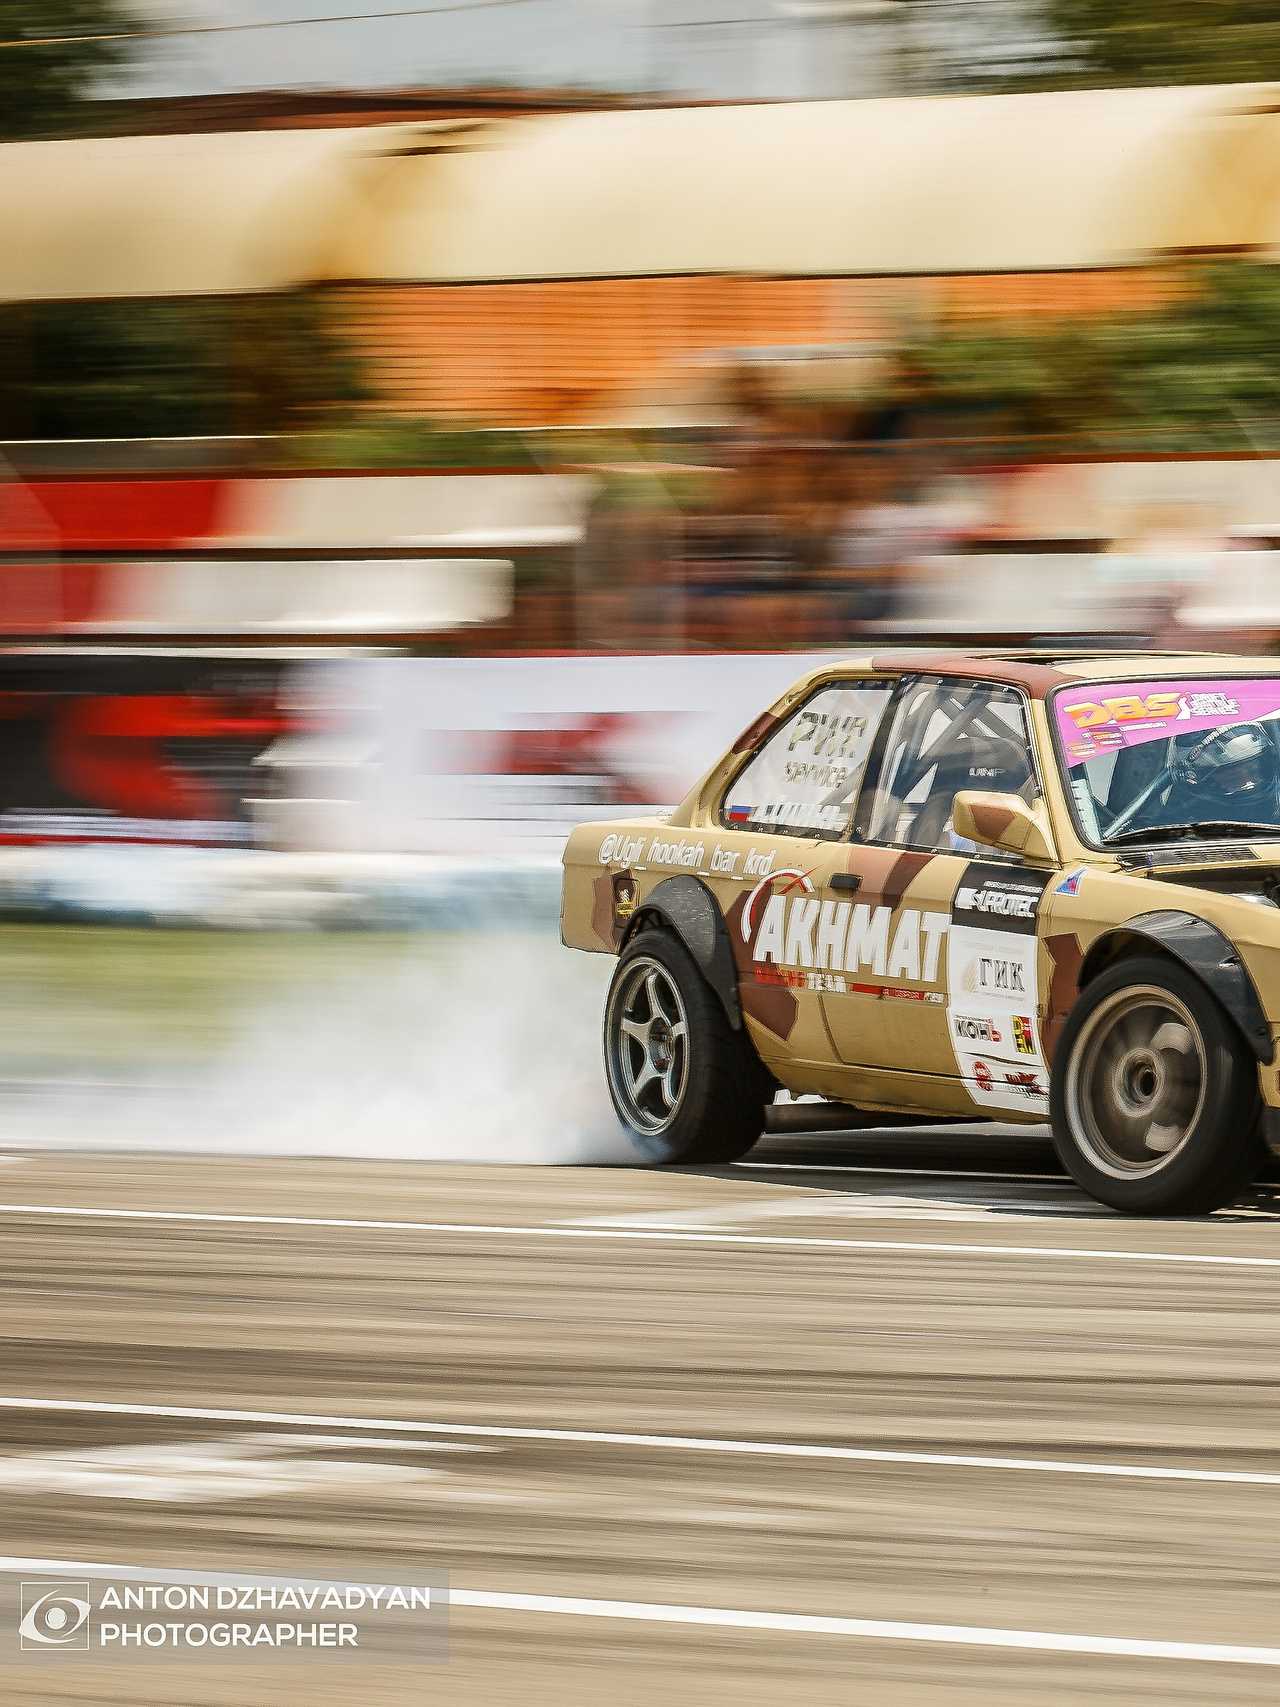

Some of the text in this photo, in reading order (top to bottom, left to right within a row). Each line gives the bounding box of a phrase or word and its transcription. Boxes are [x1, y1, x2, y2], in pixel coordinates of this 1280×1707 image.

[1062, 693, 1182, 729] DBS
[753, 894, 953, 983] AKHMAT
[979, 957, 1026, 992] ГИК
